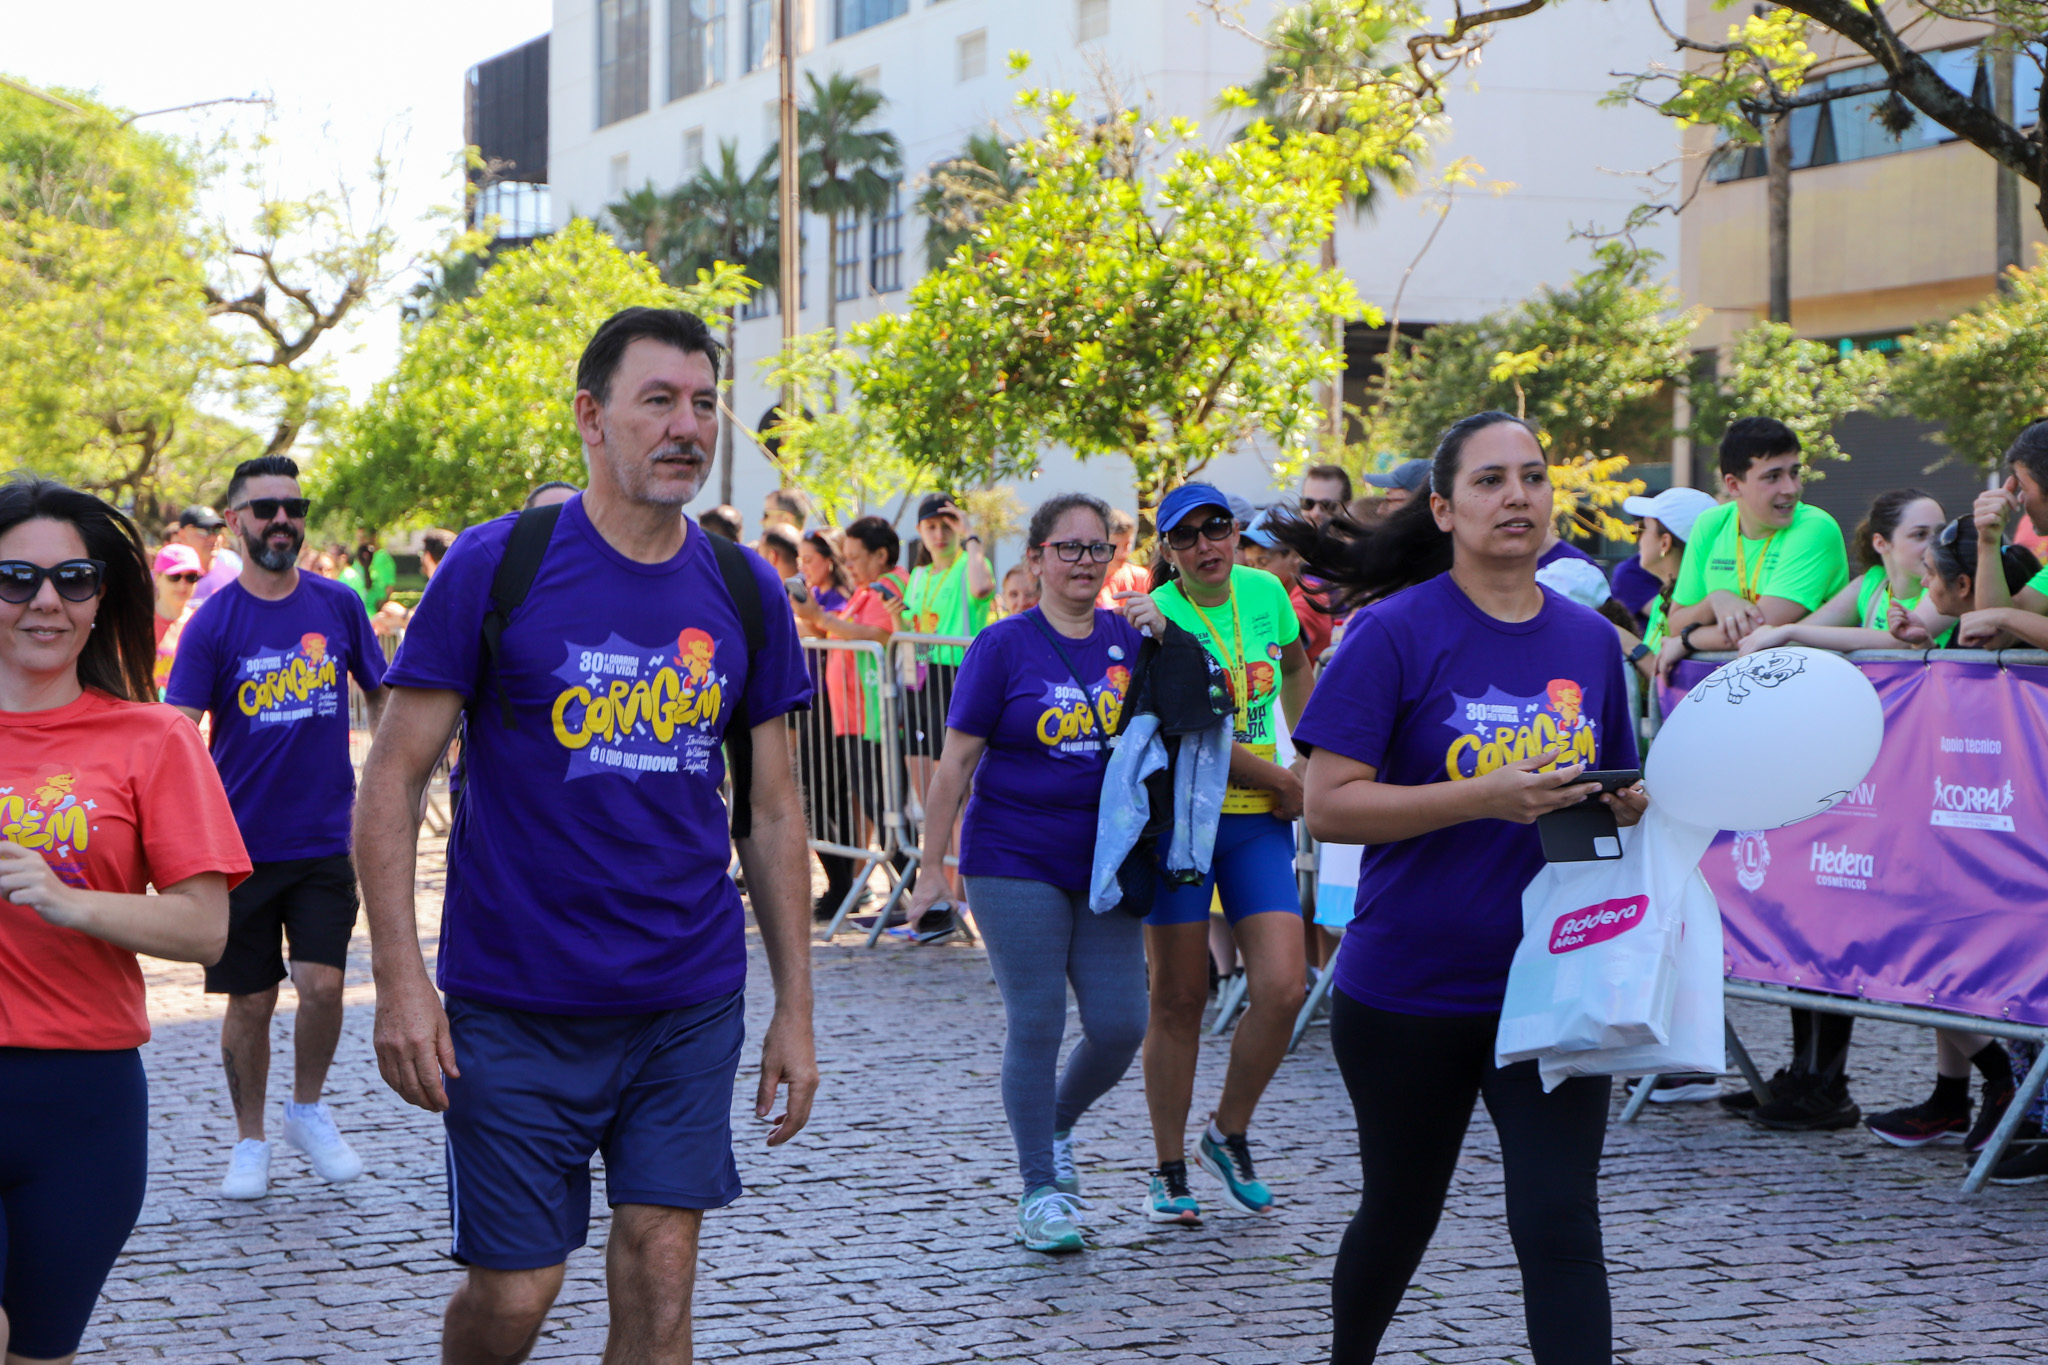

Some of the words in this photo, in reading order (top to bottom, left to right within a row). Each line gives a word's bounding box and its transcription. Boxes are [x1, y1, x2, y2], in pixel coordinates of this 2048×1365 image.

[238, 657, 336, 717] CORAGEM
[615, 664, 638, 678] VIDA
[552, 666, 721, 749] CORAGEM
[1943, 784, 2000, 813] CORPA
[1810, 841, 1874, 878] Hedera
[1559, 904, 1638, 937] Addera
